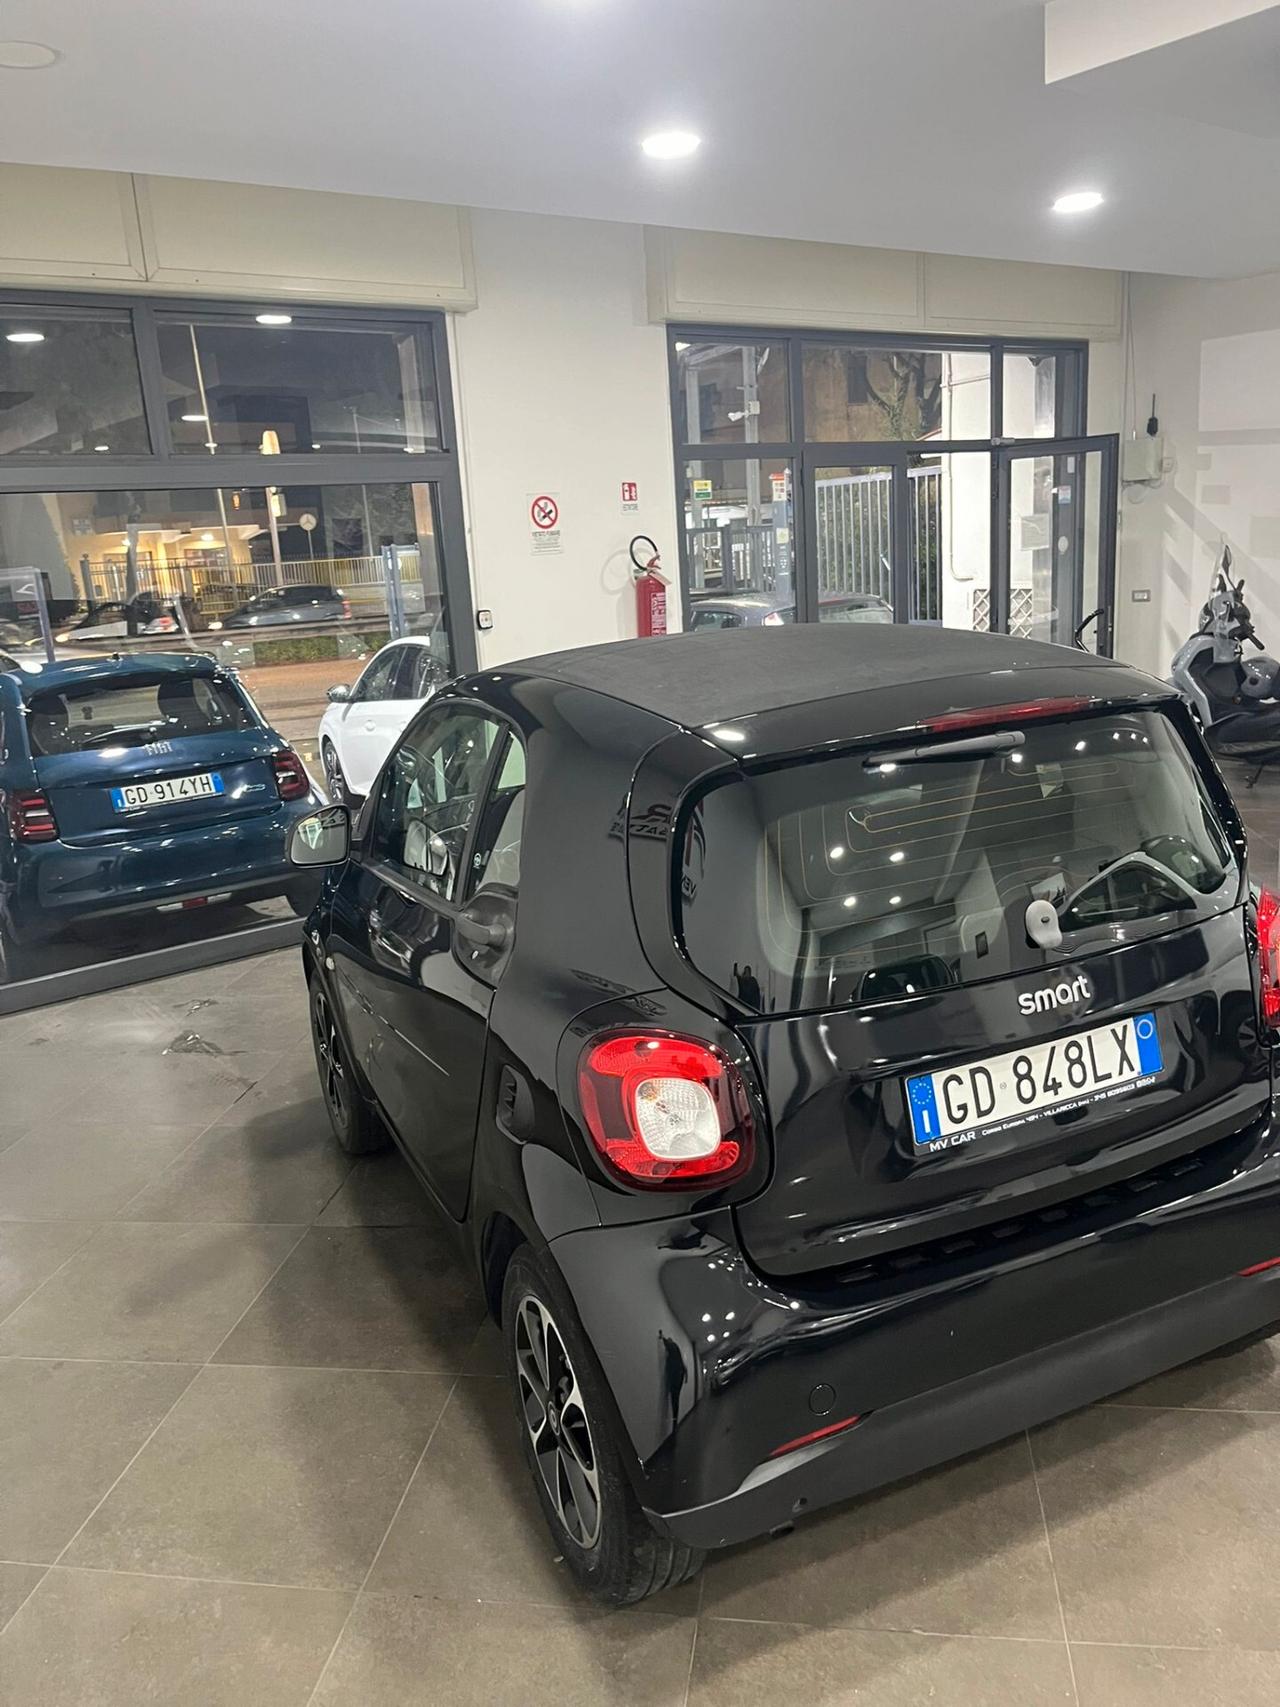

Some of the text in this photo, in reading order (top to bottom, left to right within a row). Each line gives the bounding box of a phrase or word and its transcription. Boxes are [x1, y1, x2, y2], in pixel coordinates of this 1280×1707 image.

[125, 775, 212, 805] GD 914YH
[1018, 975, 1091, 1015] smart
[942, 1024, 1135, 1124] GD 848LX
[929, 1131, 976, 1152] MV CAR
